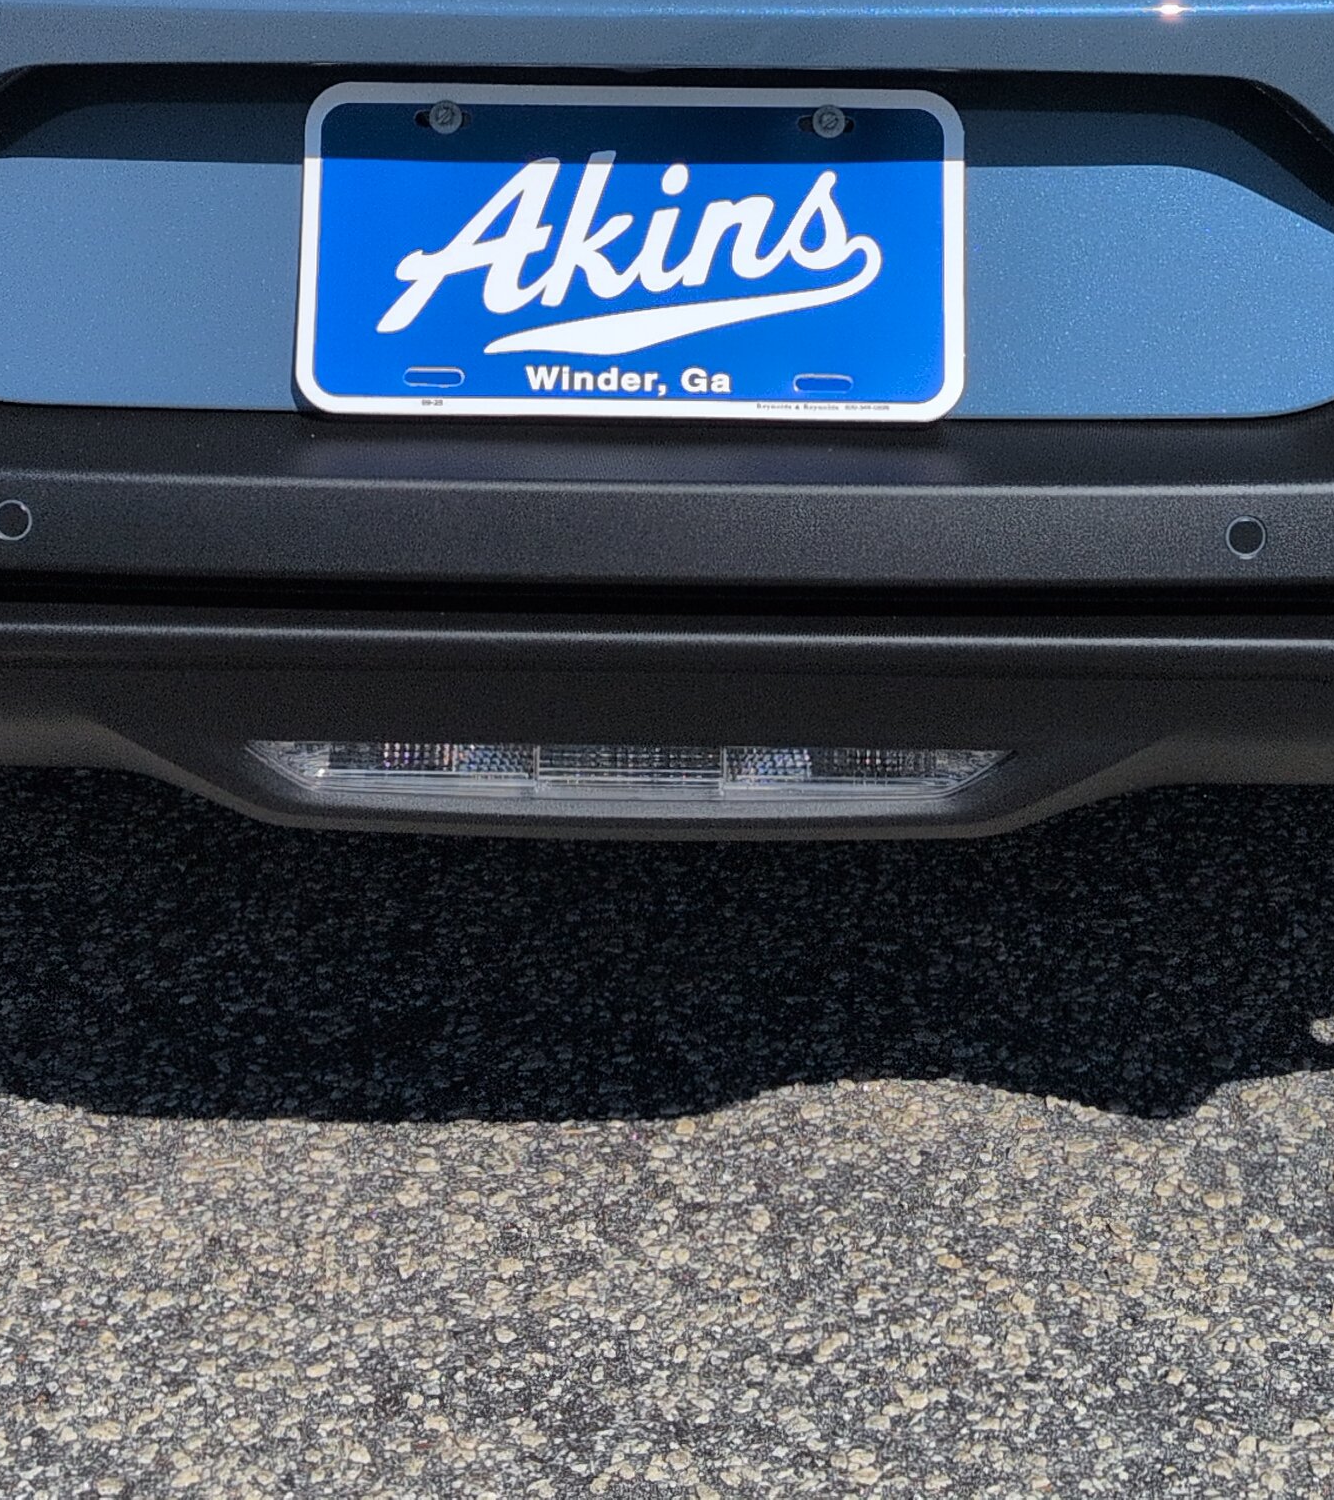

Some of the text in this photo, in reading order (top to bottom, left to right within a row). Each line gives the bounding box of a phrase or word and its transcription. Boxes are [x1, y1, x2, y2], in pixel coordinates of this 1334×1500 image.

[375, 150, 883, 355] Akins
[525, 365, 731, 396] Winder, Ga
